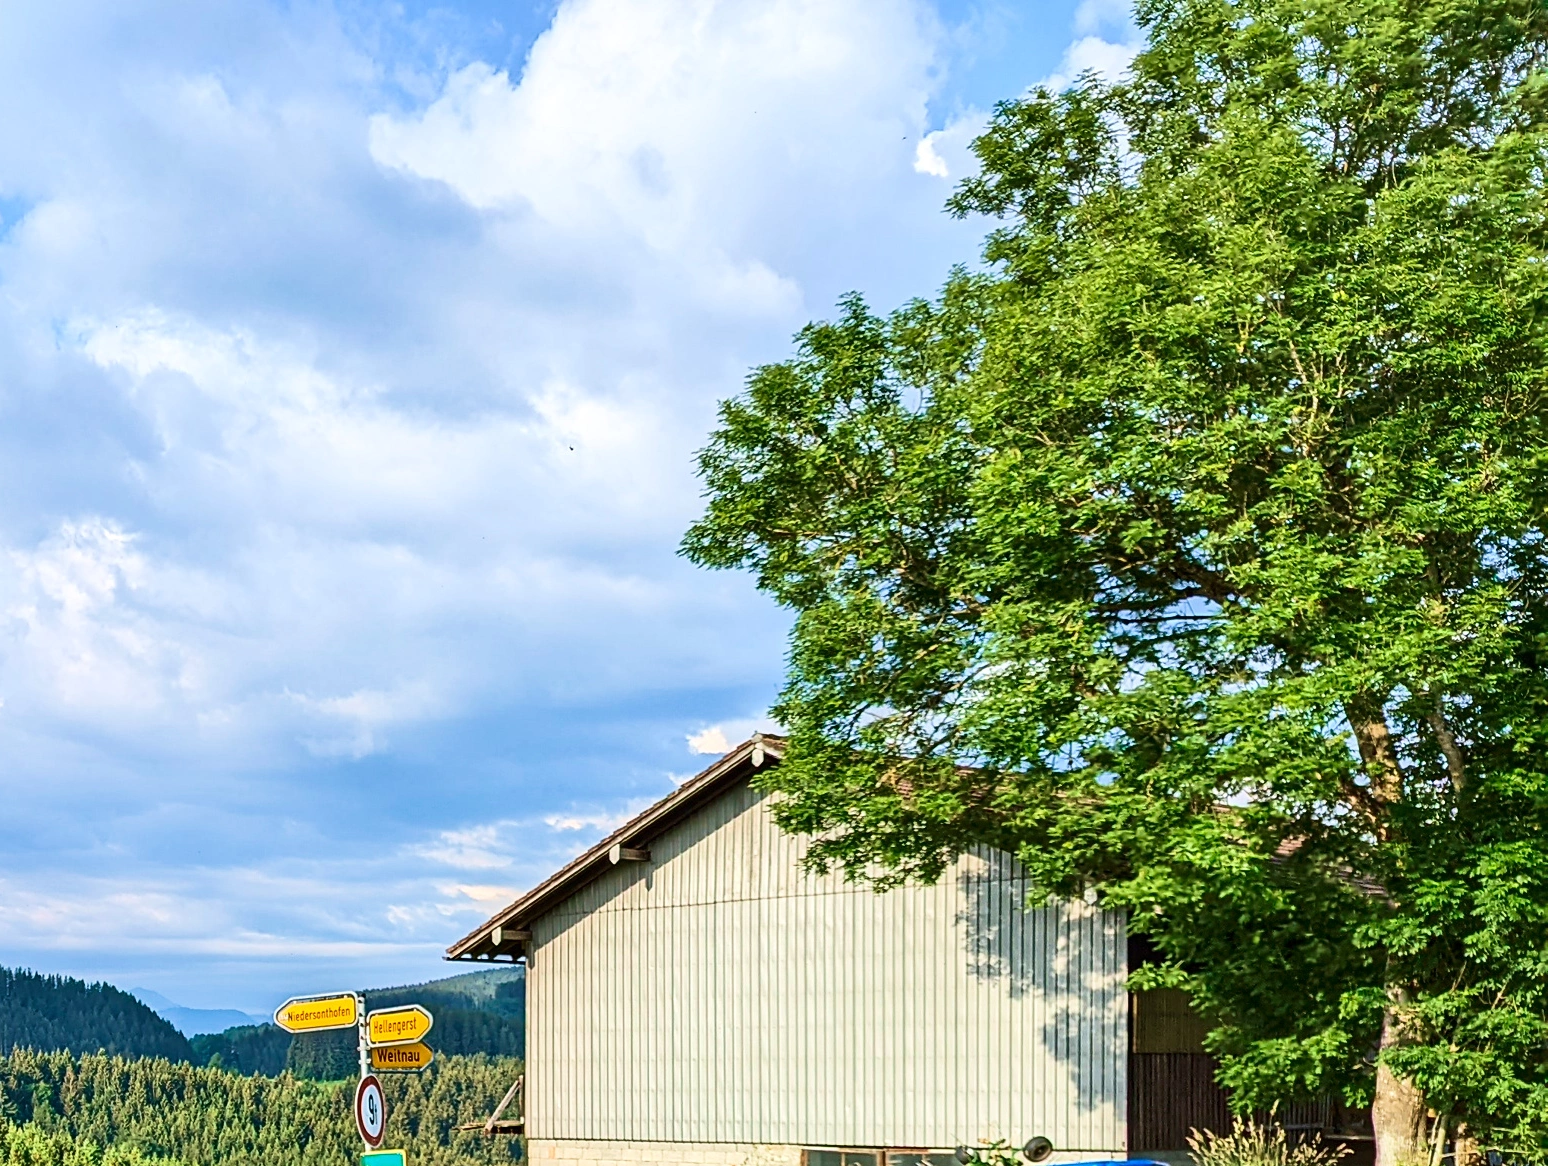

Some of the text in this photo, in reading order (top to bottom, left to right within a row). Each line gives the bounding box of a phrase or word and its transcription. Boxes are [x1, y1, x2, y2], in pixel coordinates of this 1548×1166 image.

[288, 1006, 351, 1023] Niedersonthofen
[374, 1016, 417, 1035] Hellengerst
[377, 1049, 420, 1062] Weitnau
